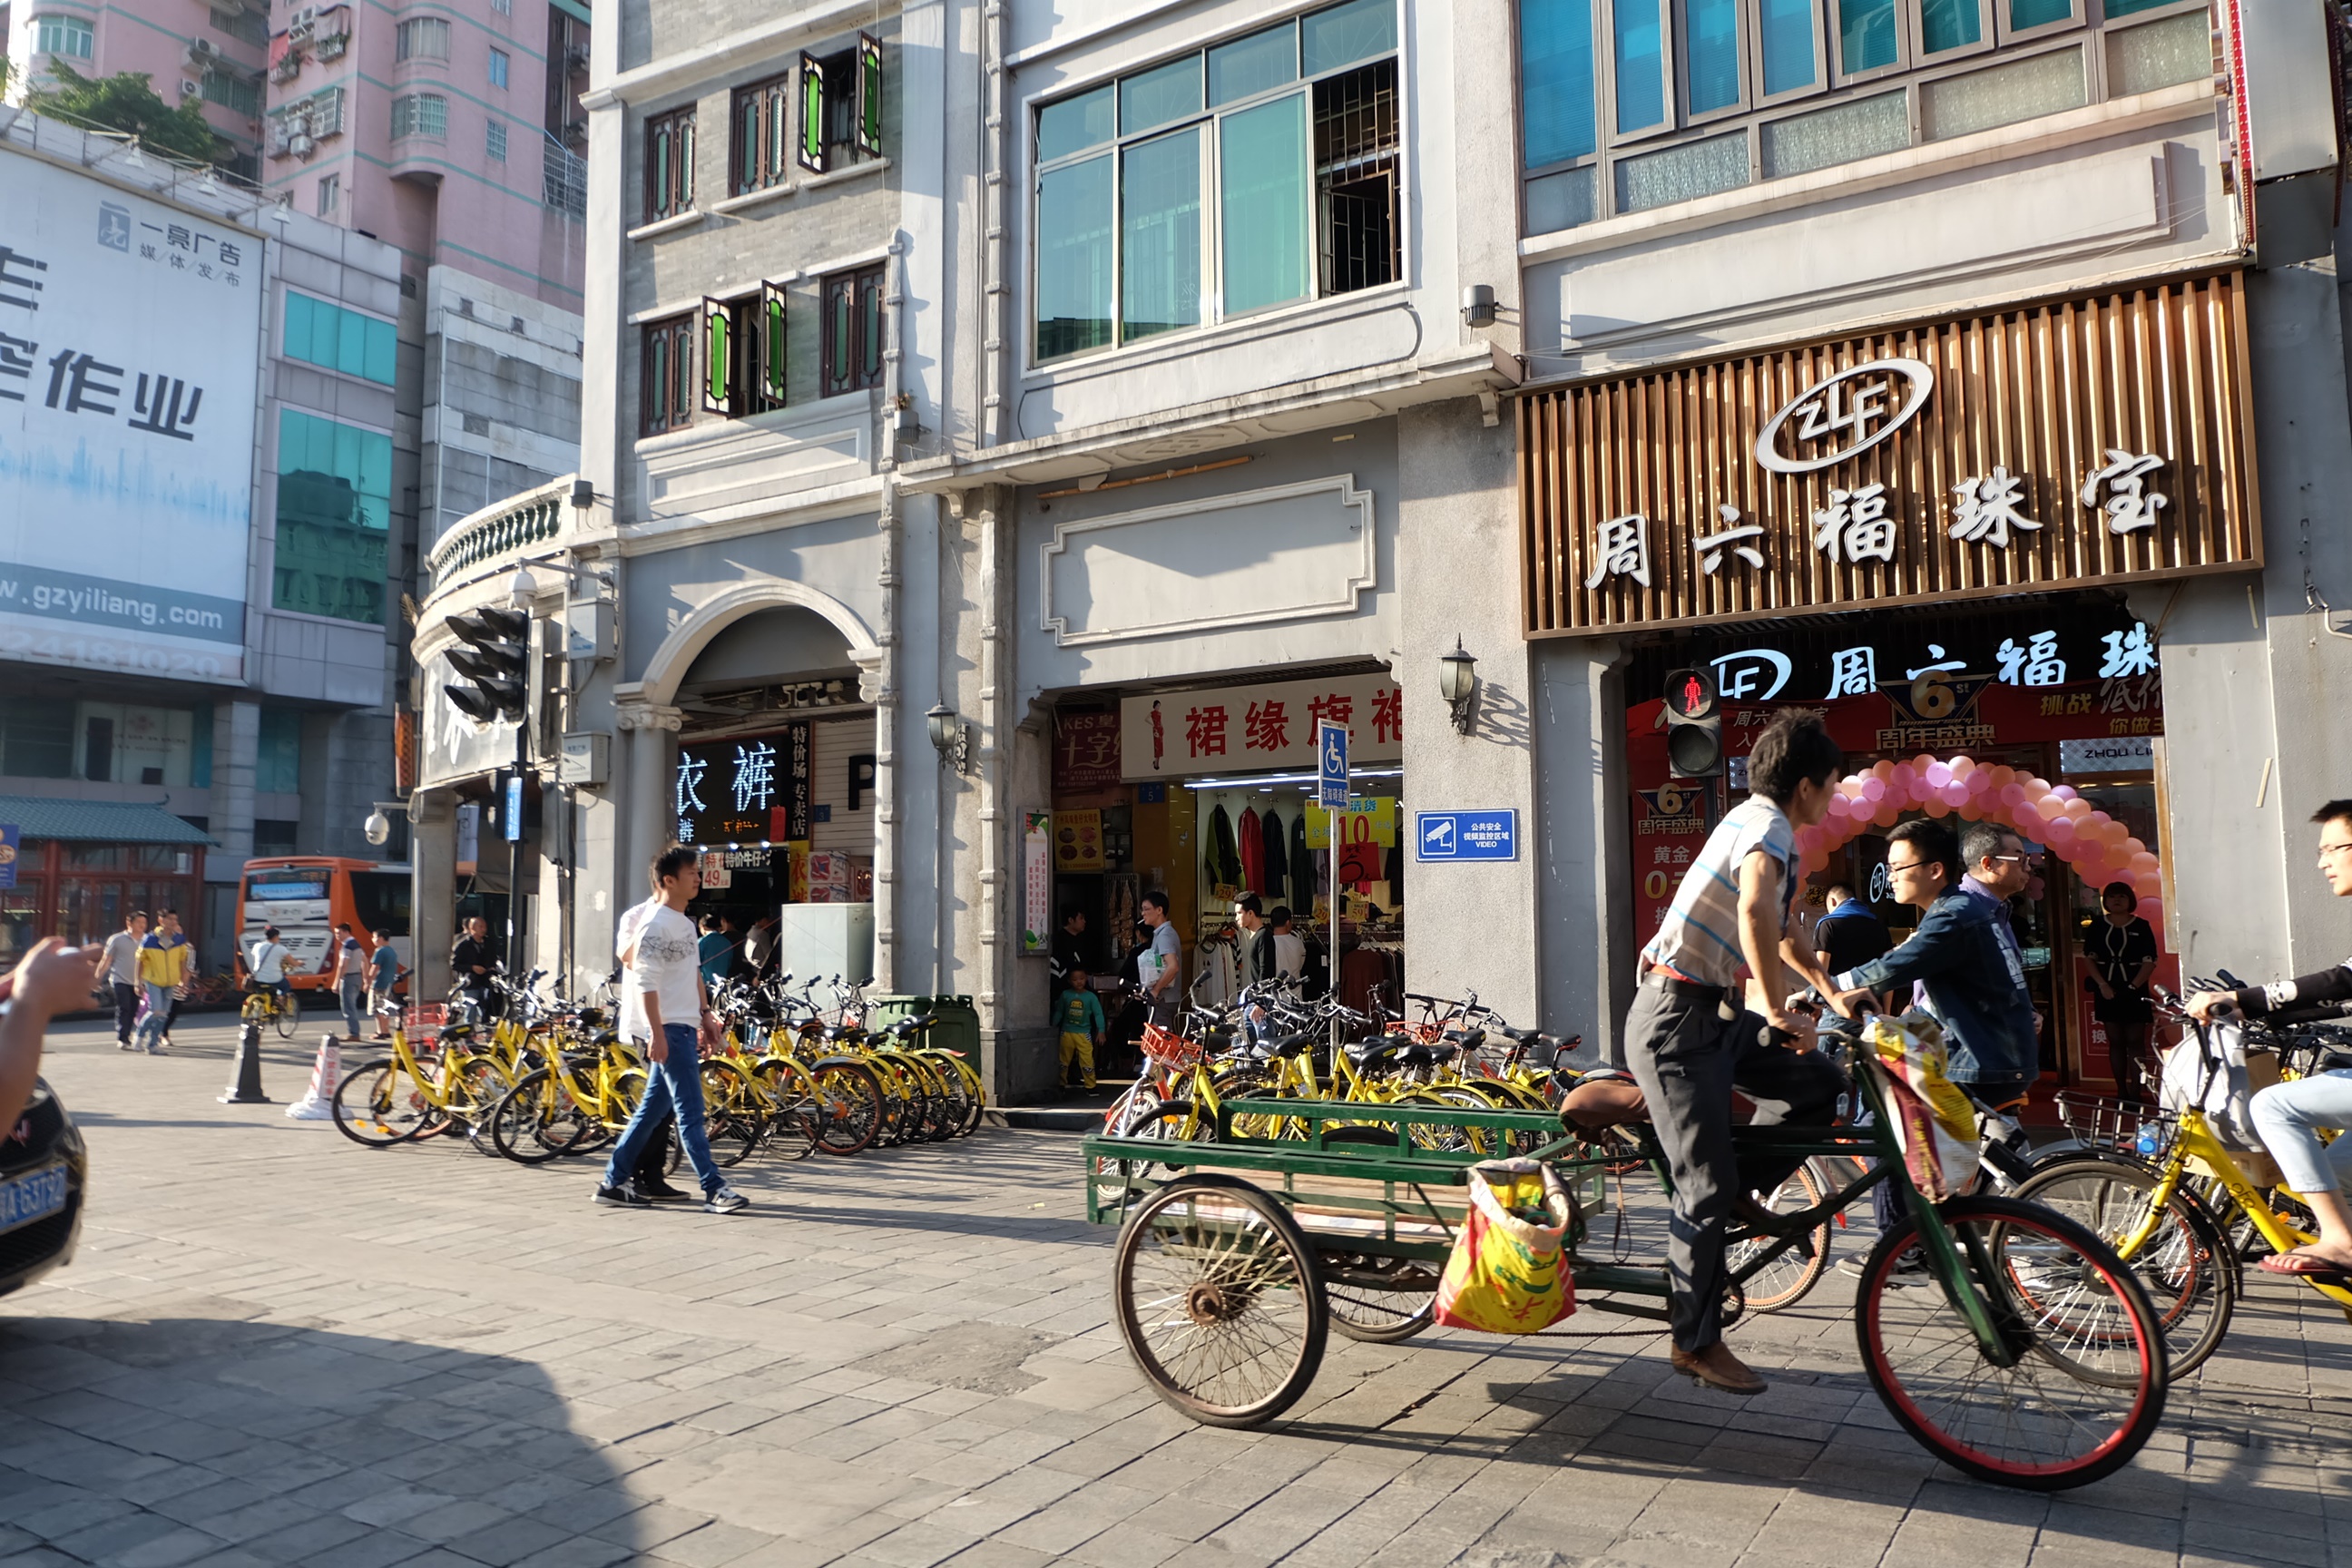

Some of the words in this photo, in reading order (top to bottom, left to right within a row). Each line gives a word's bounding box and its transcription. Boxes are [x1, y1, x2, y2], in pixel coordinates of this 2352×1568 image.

[140, 221, 241, 268] 一亮广告
[1795, 379, 1888, 445] ZLF
[1585, 447, 2170, 591] 周六福珠宝
[2040, 692, 2092, 716] 挑战
[1063, 715, 1094, 730] KES
[1185, 687, 1403, 759] 裙缘旗袍
[1875, 723, 1996, 751] 周年盛典
[791, 726, 808, 779] 特价场
[2084, 748, 2129, 760] ZHOU
[676, 740, 777, 816] 衣裤
[1148, 790, 1154, 801] 5
[1322, 787, 1348, 803] 无障碍通道
[791, 783, 808, 836] 专卖店
[1470, 821, 1502, 832] 公共安全
[1637, 818, 1705, 836] 周年盛典
[1463, 831, 1510, 841] 视频监控区域
[1475, 840, 1497, 848] VIDEO
[1653, 845, 1690, 865] 黄金
[704, 869, 720, 887] 49
[1218, 888, 1231, 899] 29
[1316, 908, 1328, 921] 29
[1352, 908, 1364, 918] 59
[2092, 1028, 2108, 1044] 换
